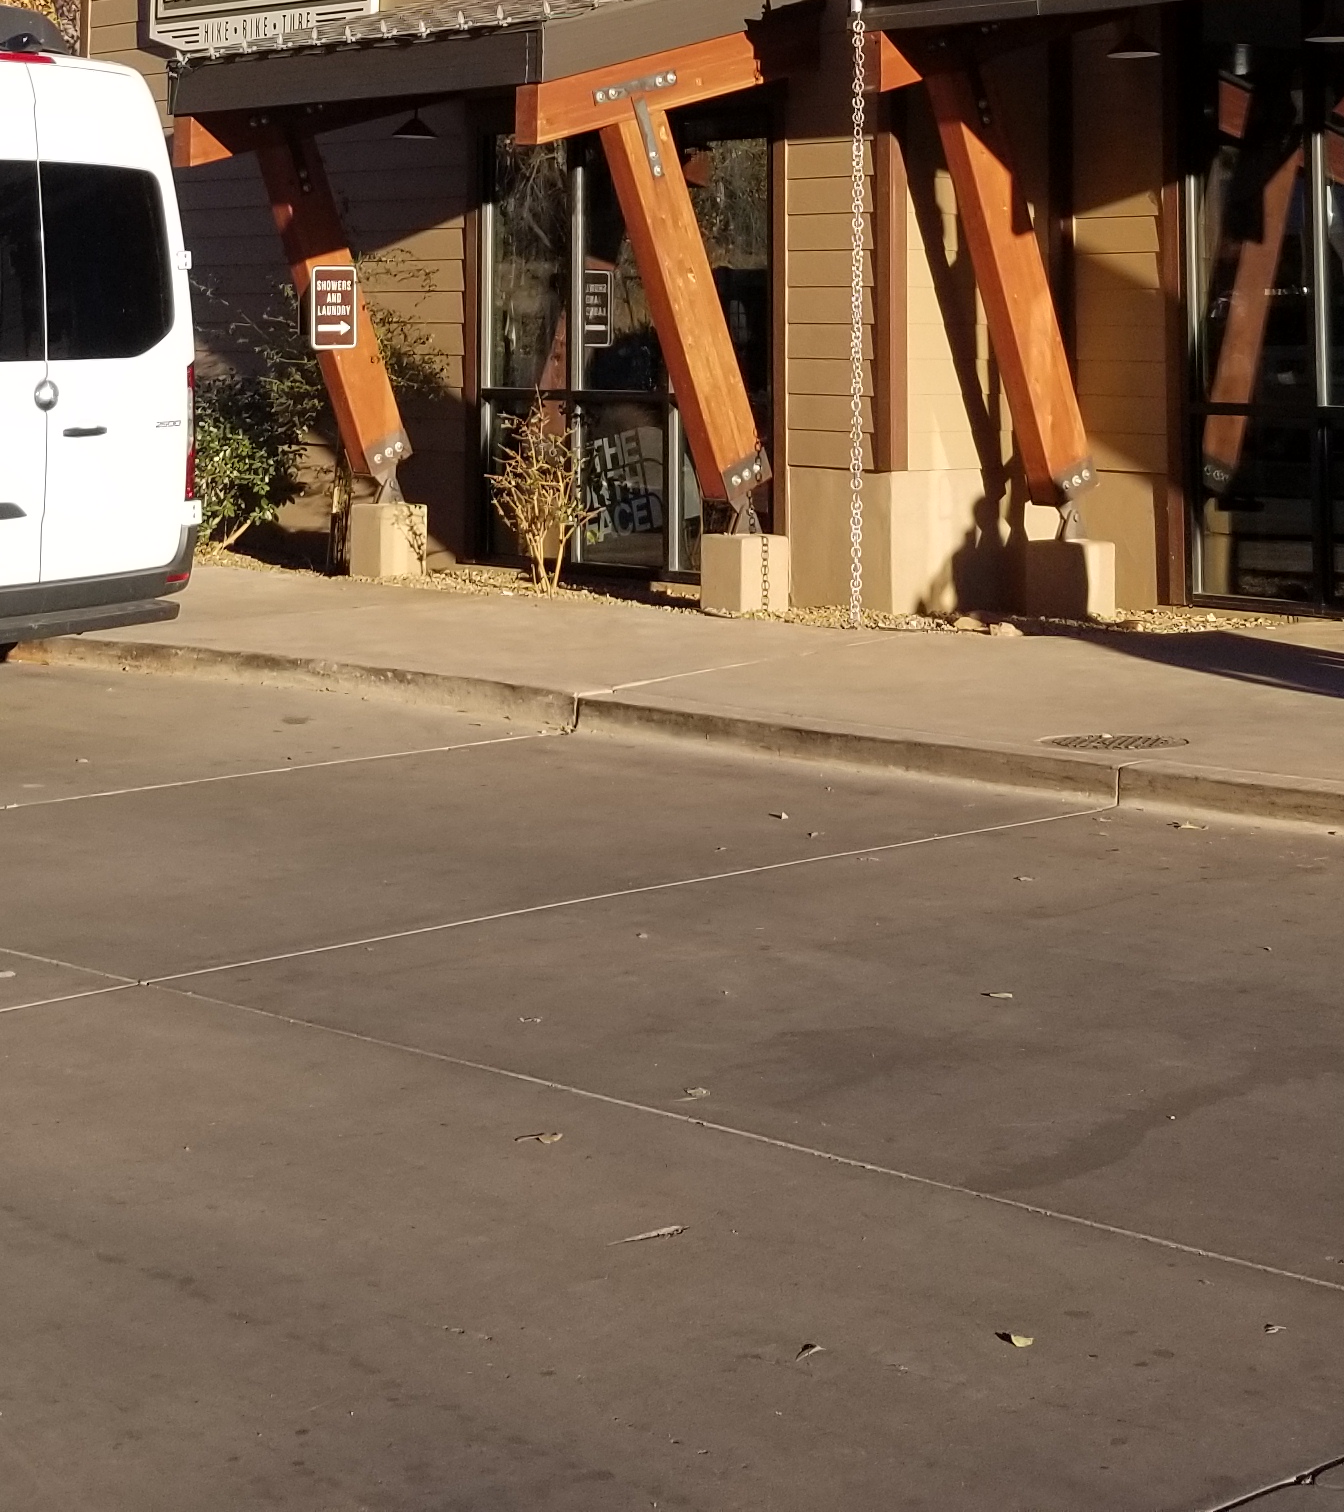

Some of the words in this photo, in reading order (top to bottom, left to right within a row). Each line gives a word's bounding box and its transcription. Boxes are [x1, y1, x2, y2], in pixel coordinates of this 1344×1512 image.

[204, 21, 229, 43] HIKE
[243, 17, 268, 39] BIKE
[316, 280, 352, 291] SHOWERS
[326, 292, 342, 303] AND
[317, 305, 351, 316] LAUNDRY
